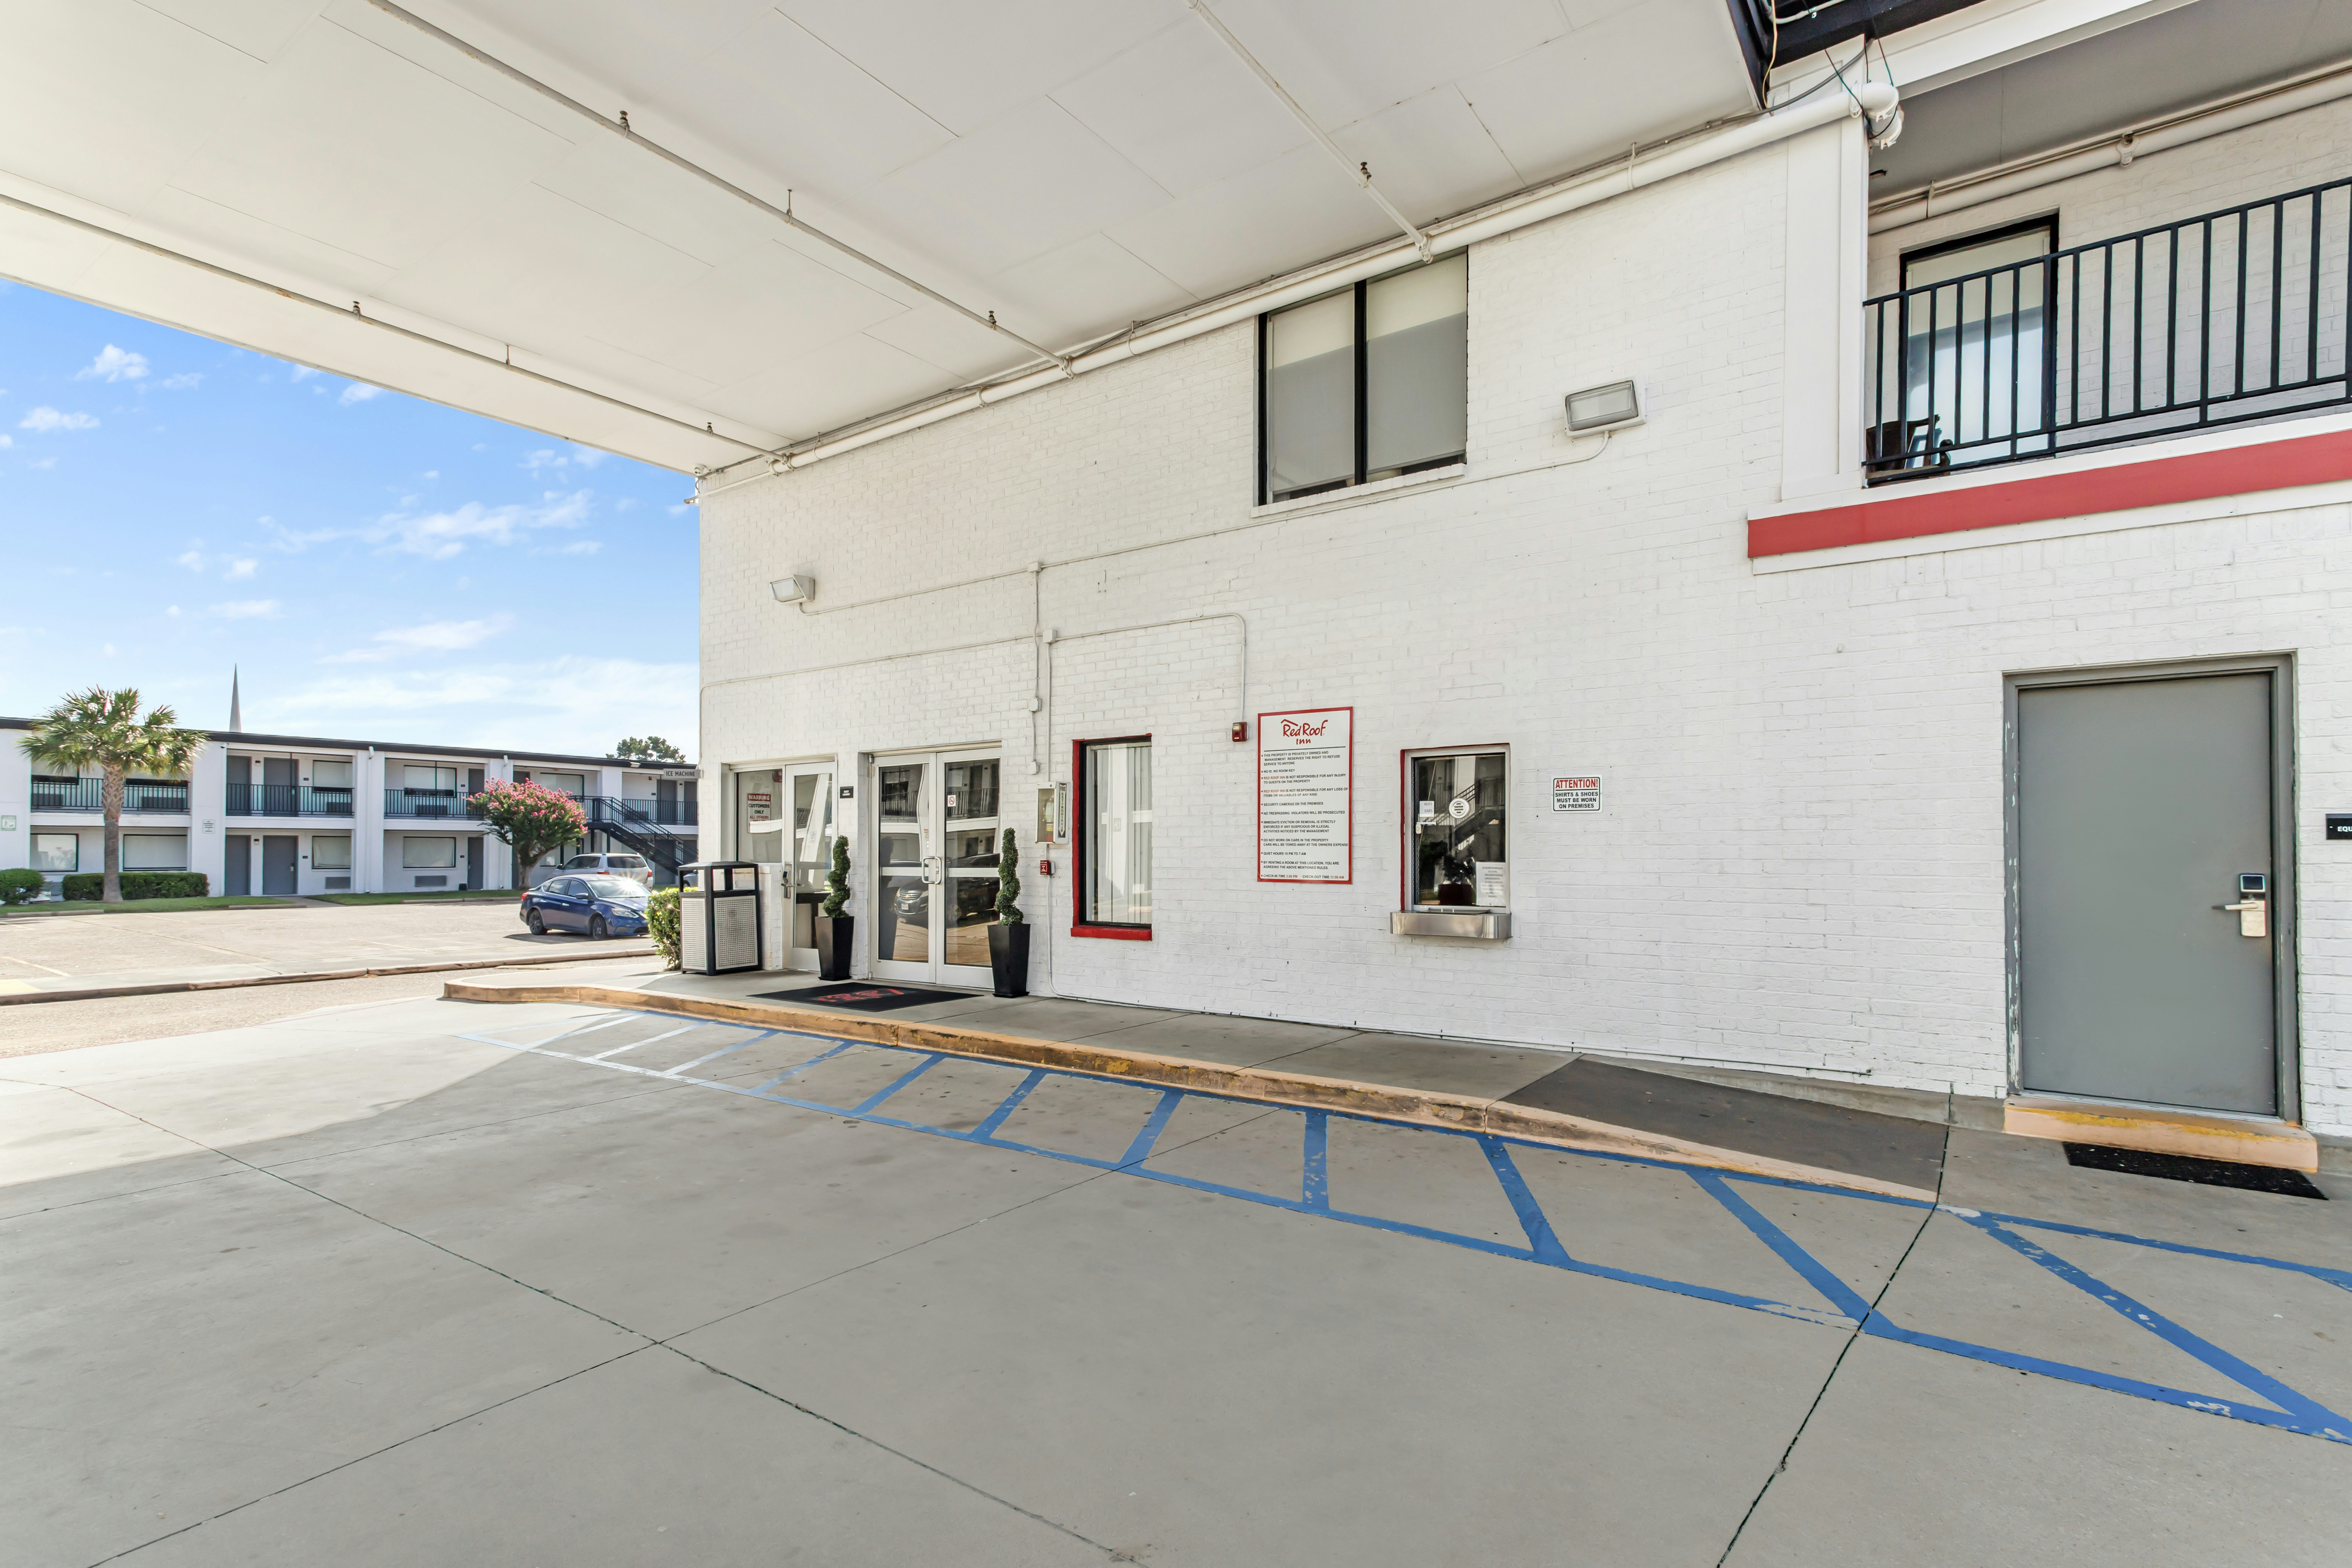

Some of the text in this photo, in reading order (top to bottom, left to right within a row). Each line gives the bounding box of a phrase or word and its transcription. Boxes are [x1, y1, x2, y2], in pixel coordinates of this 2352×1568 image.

[1283, 720, 1328, 737] Red Roof
[1556, 779, 1598, 788] ATTENTION!
